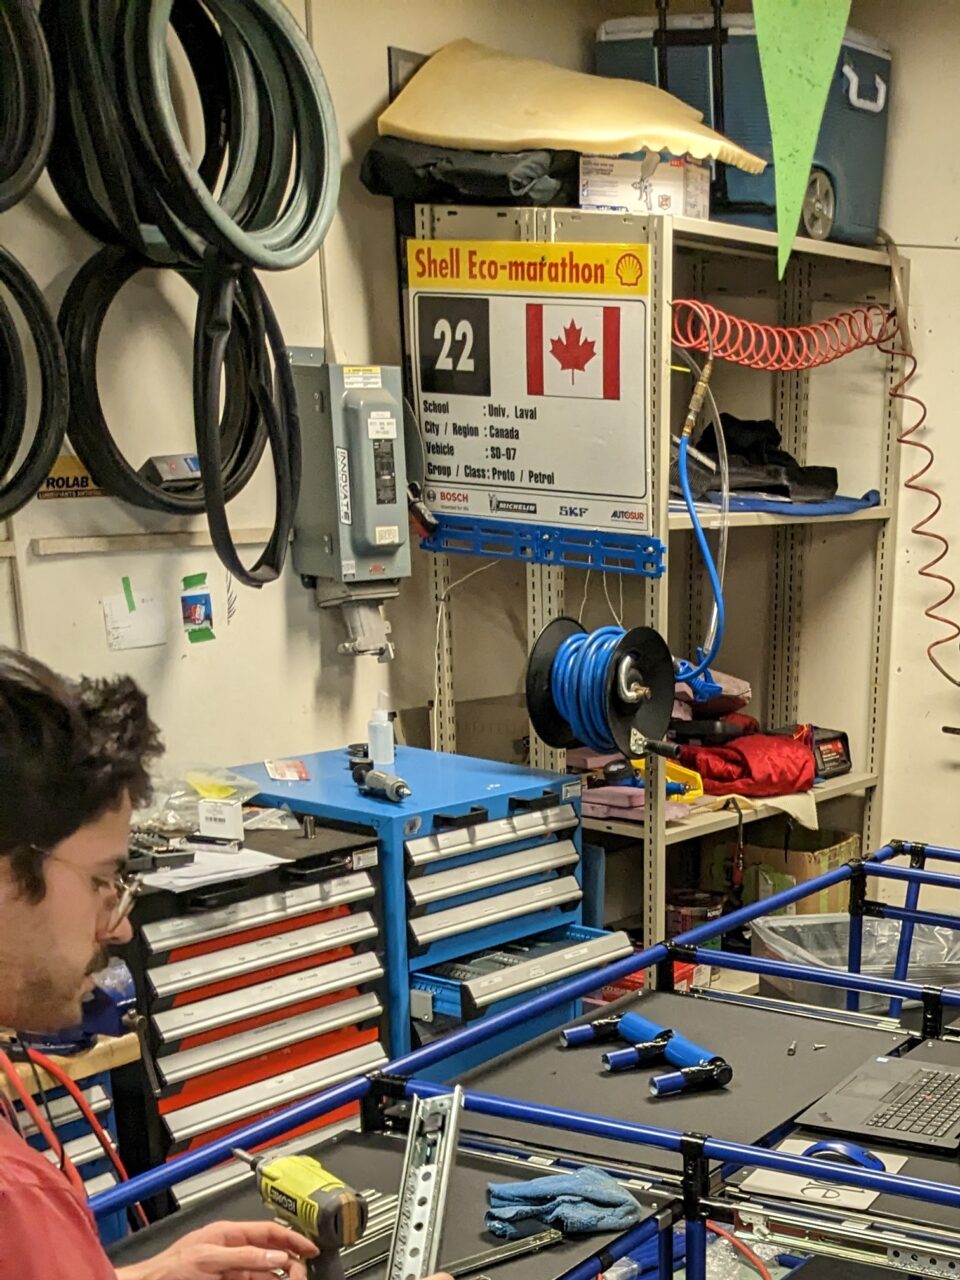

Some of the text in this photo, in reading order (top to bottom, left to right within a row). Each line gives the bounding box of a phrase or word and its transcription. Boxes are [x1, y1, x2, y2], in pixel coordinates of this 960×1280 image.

[415, 247, 605, 285] Shell Eco-marathon
[433, 318, 475, 372] 22
[423, 400, 449, 414] School
[514, 405, 537, 420] Laval
[424, 421, 440, 436] City
[452, 422, 479, 438] Region
[489, 425, 520, 440] Canada
[426, 442, 454, 456] Vehicle
[427, 462, 452, 478] Group
[529, 470, 555, 485] Petrol
[46, 476, 89, 489] ROLAB
[440, 492, 469, 503] BOSCH
[499, 502, 536, 512] MICHELIN
[559, 506, 588, 518] SKF
[611, 510, 644, 521] AUTOSUR
